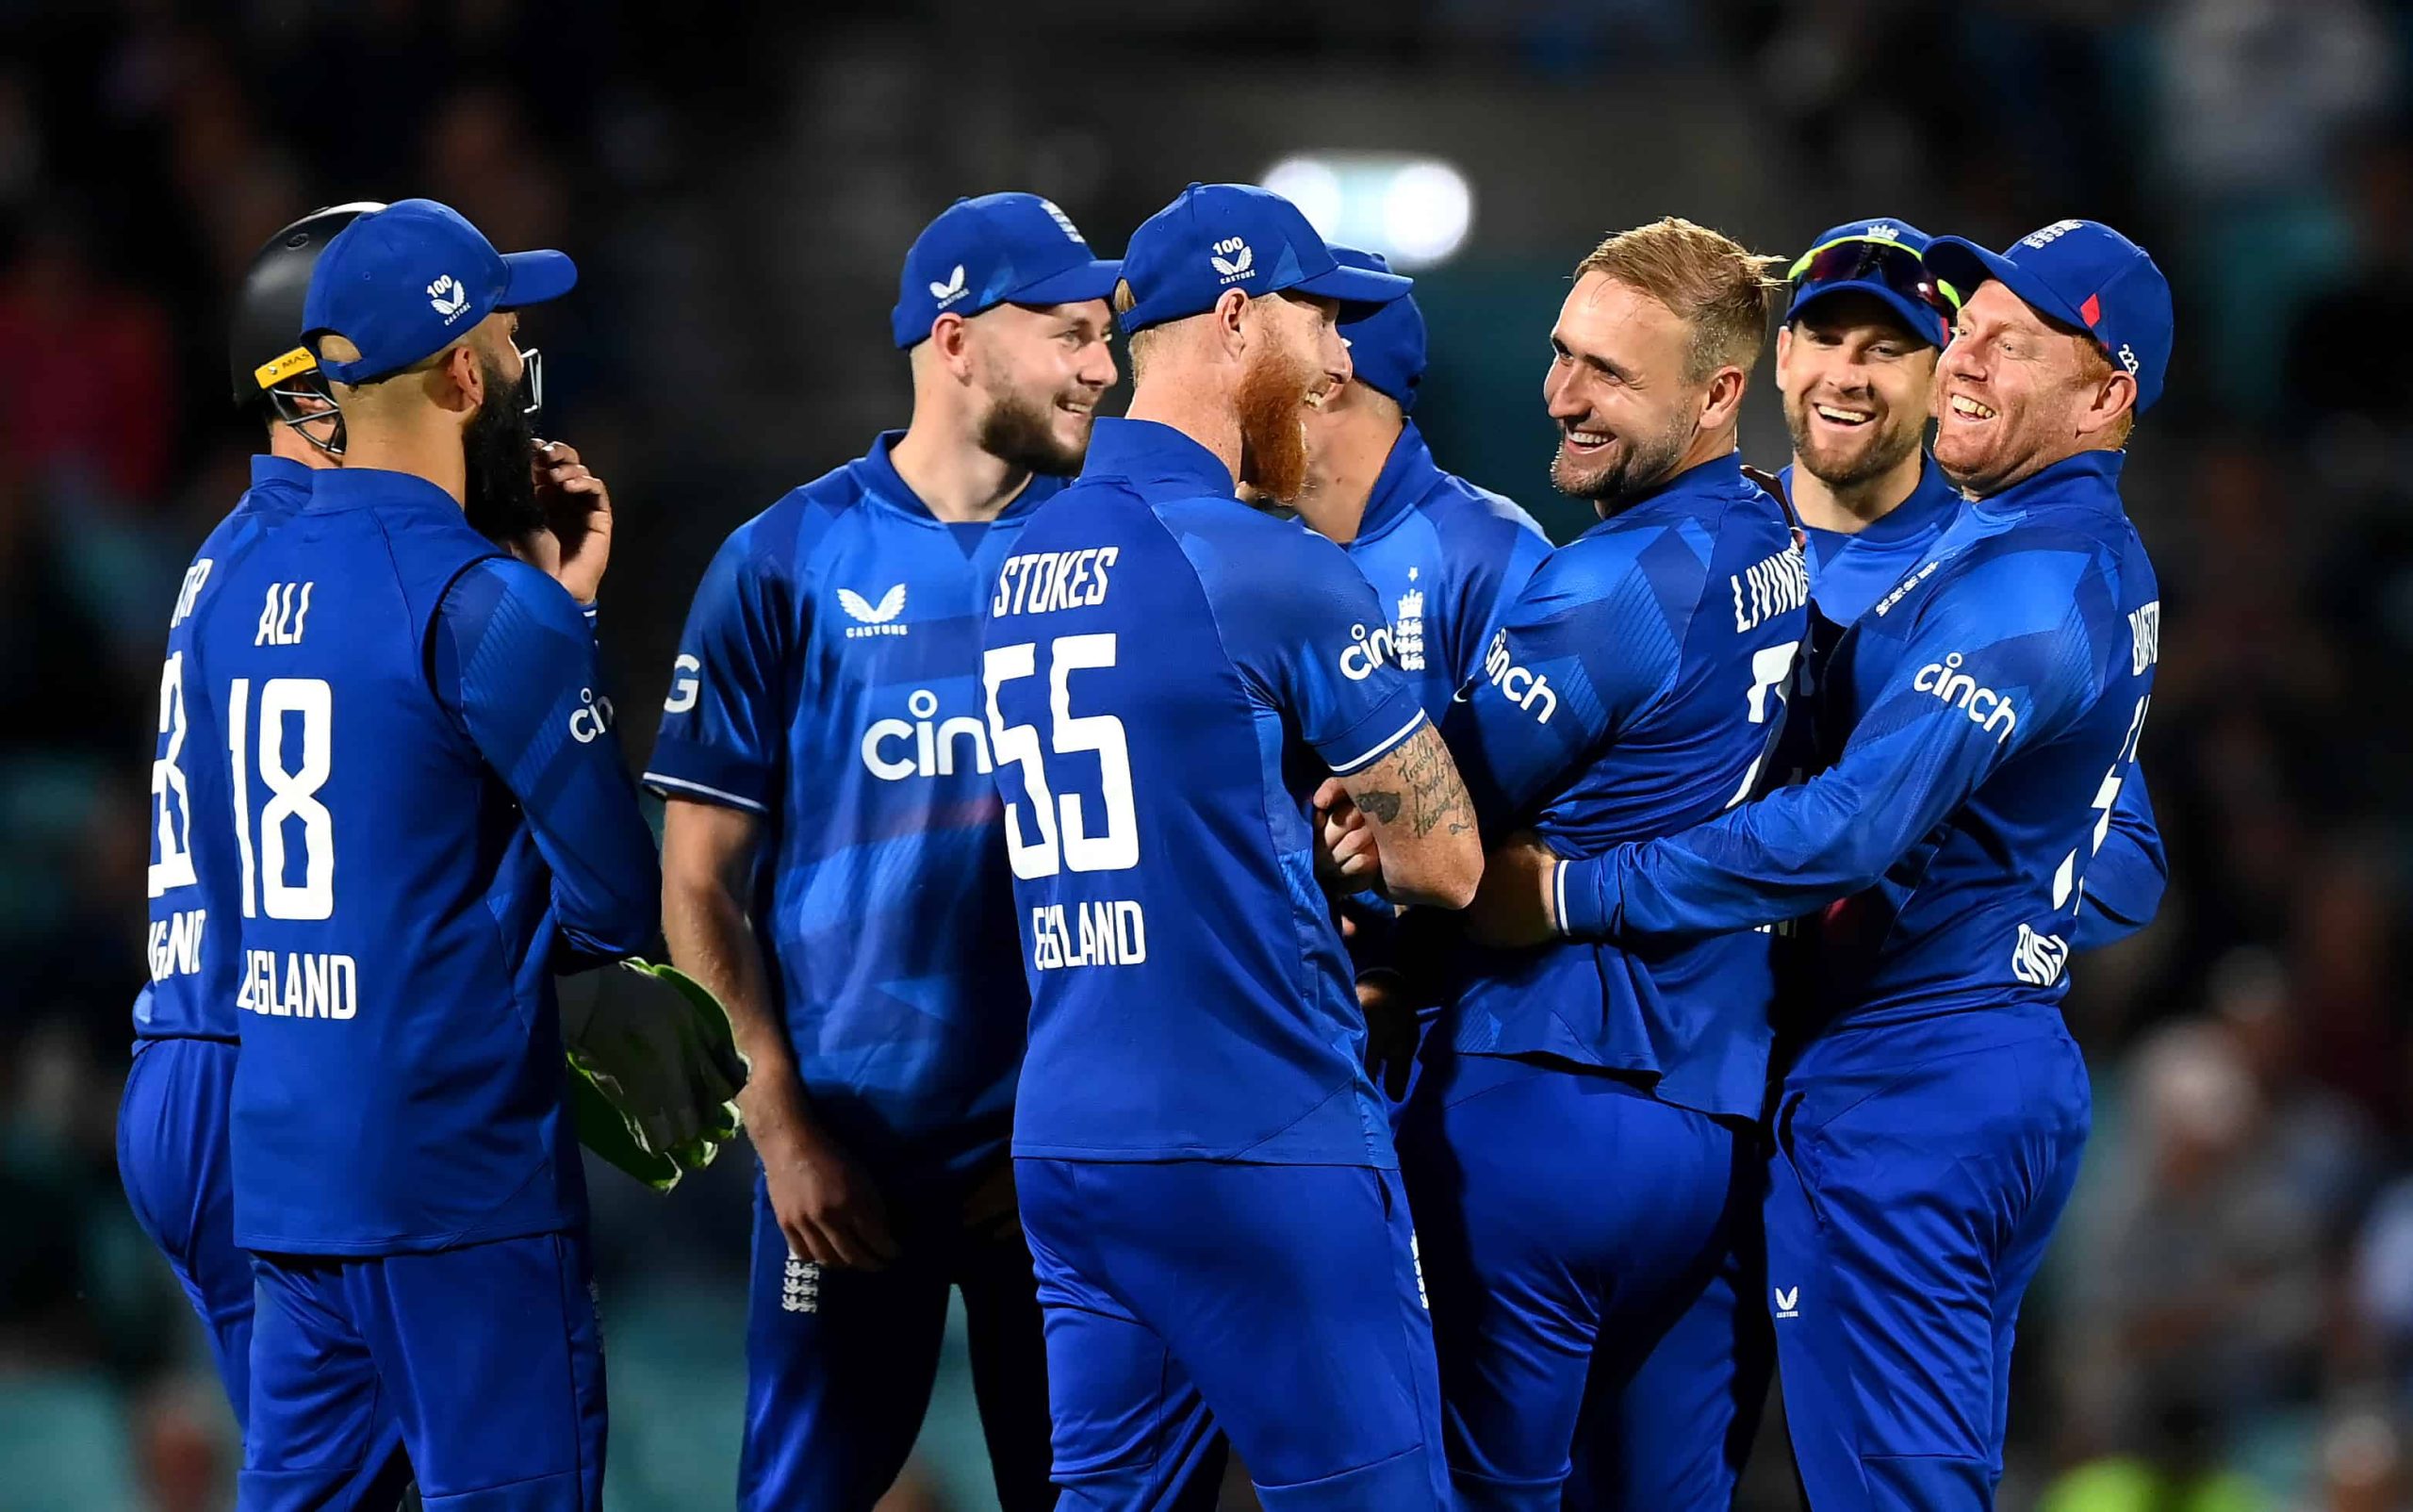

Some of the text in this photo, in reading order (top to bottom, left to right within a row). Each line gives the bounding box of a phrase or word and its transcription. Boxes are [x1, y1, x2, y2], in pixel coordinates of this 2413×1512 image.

[1212, 236, 1244, 256] 100
[426, 273, 452, 299] 100
[1219, 269, 1256, 285] CASTORE
[443, 302, 472, 326] CASTORE
[282, 353, 311, 370] MAS
[992, 546, 1119, 618] STOKES
[254, 581, 315, 647] ALI
[845, 623, 909, 639] CASTORE
[1339, 623, 1394, 681] cin
[1486, 627, 1557, 725] cinch
[664, 653, 700, 714] G
[1913, 652, 2017, 745] cinch
[568, 687, 614, 744] cin
[861, 689, 994, 781] cin
[982, 633, 1140, 881] 55
[228, 677, 335, 921] 18
